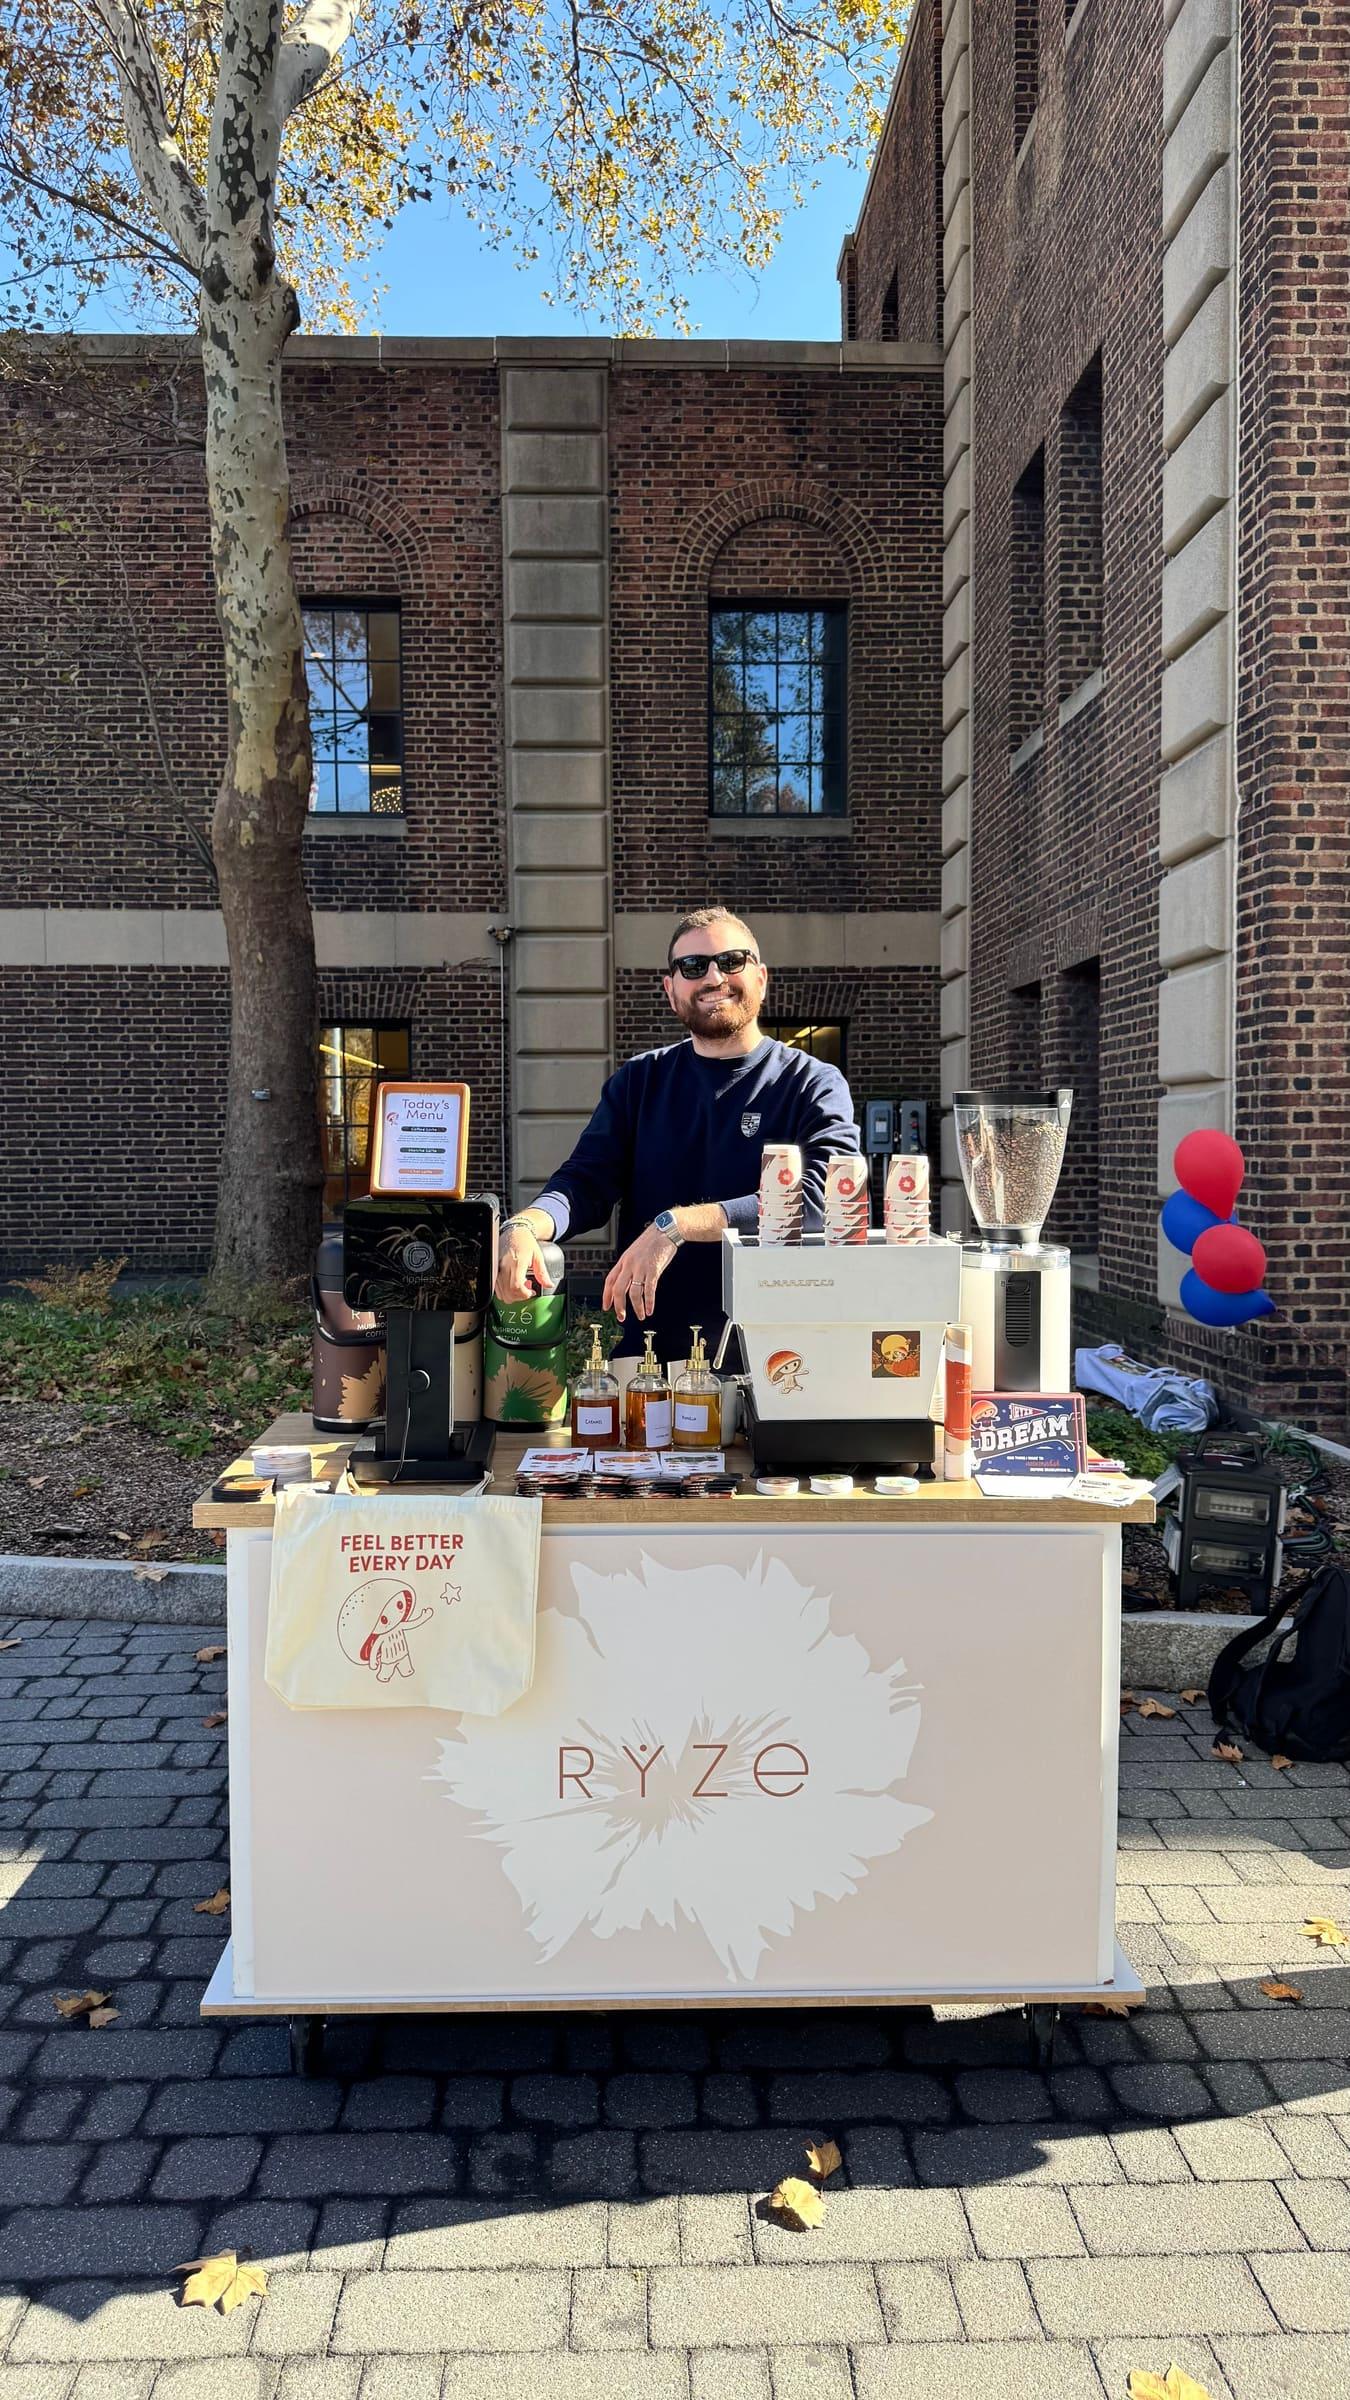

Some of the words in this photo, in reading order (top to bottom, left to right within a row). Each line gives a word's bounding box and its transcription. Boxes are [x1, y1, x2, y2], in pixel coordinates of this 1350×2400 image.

[402, 1098, 450, 1111] Today's
[406, 1109, 444, 1120] Menu
[979, 1415, 1070, 1452] DREAM
[340, 1534, 385, 1552] FEEL
[390, 1533, 464, 1551] BETTER
[349, 1555, 410, 1573] EVERY
[415, 1554, 456, 1571] DAY
